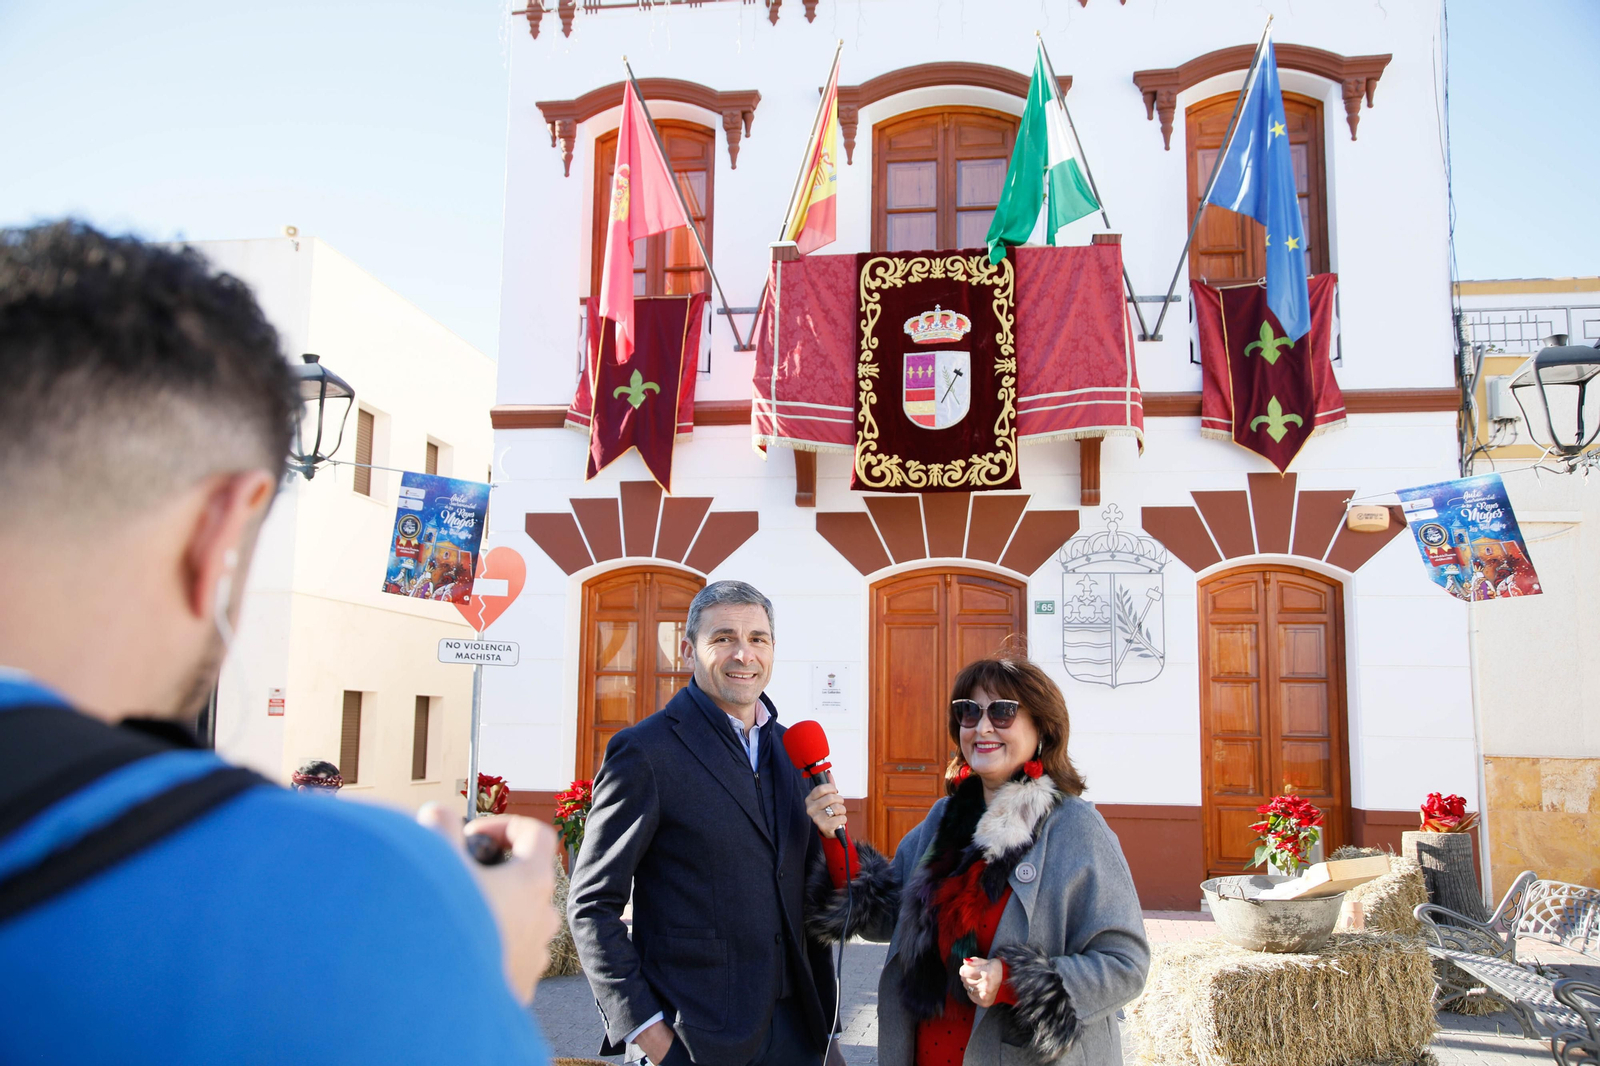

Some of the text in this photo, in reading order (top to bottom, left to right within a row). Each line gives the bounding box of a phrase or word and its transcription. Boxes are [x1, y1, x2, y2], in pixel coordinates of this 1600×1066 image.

[1476, 501, 1499, 511] Reyes
[456, 508, 475, 518] Reyes
[1460, 508, 1503, 523] Magos
[440, 510, 475, 529] Magos
[445, 641, 512, 652] NO VIOLENCIA
[455, 652, 502, 661] MACHISTA
